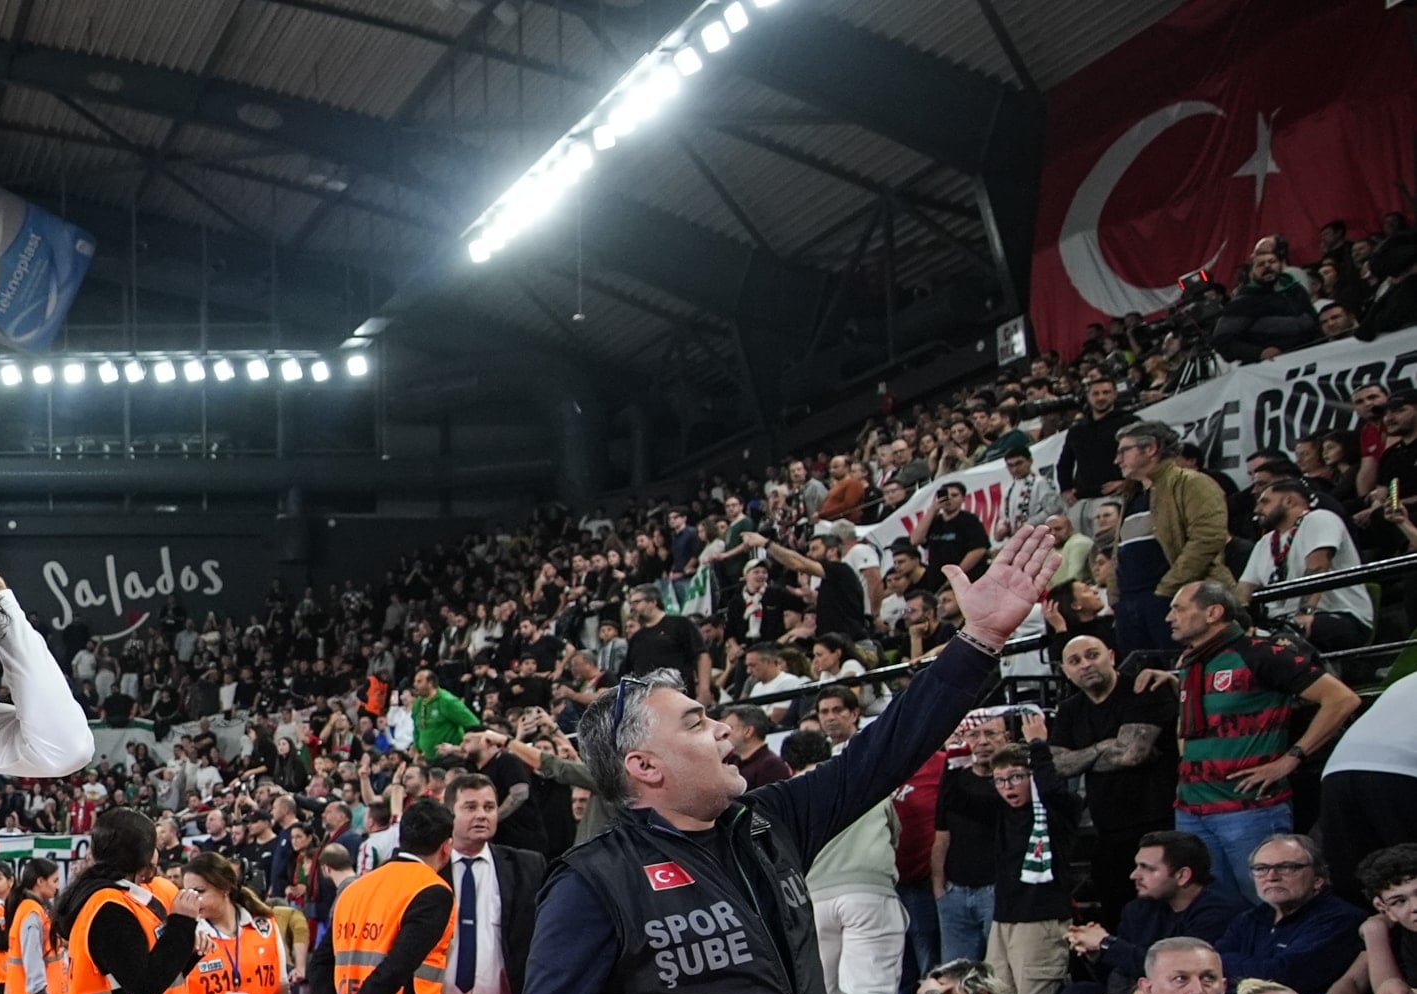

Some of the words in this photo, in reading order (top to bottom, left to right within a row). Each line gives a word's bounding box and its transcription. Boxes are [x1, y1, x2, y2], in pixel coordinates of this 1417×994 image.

[43, 546, 223, 630] Salados
[644, 900, 743, 949] SPOR
[255, 964, 275, 988] 176
[654, 930, 754, 989] ŞUBE
